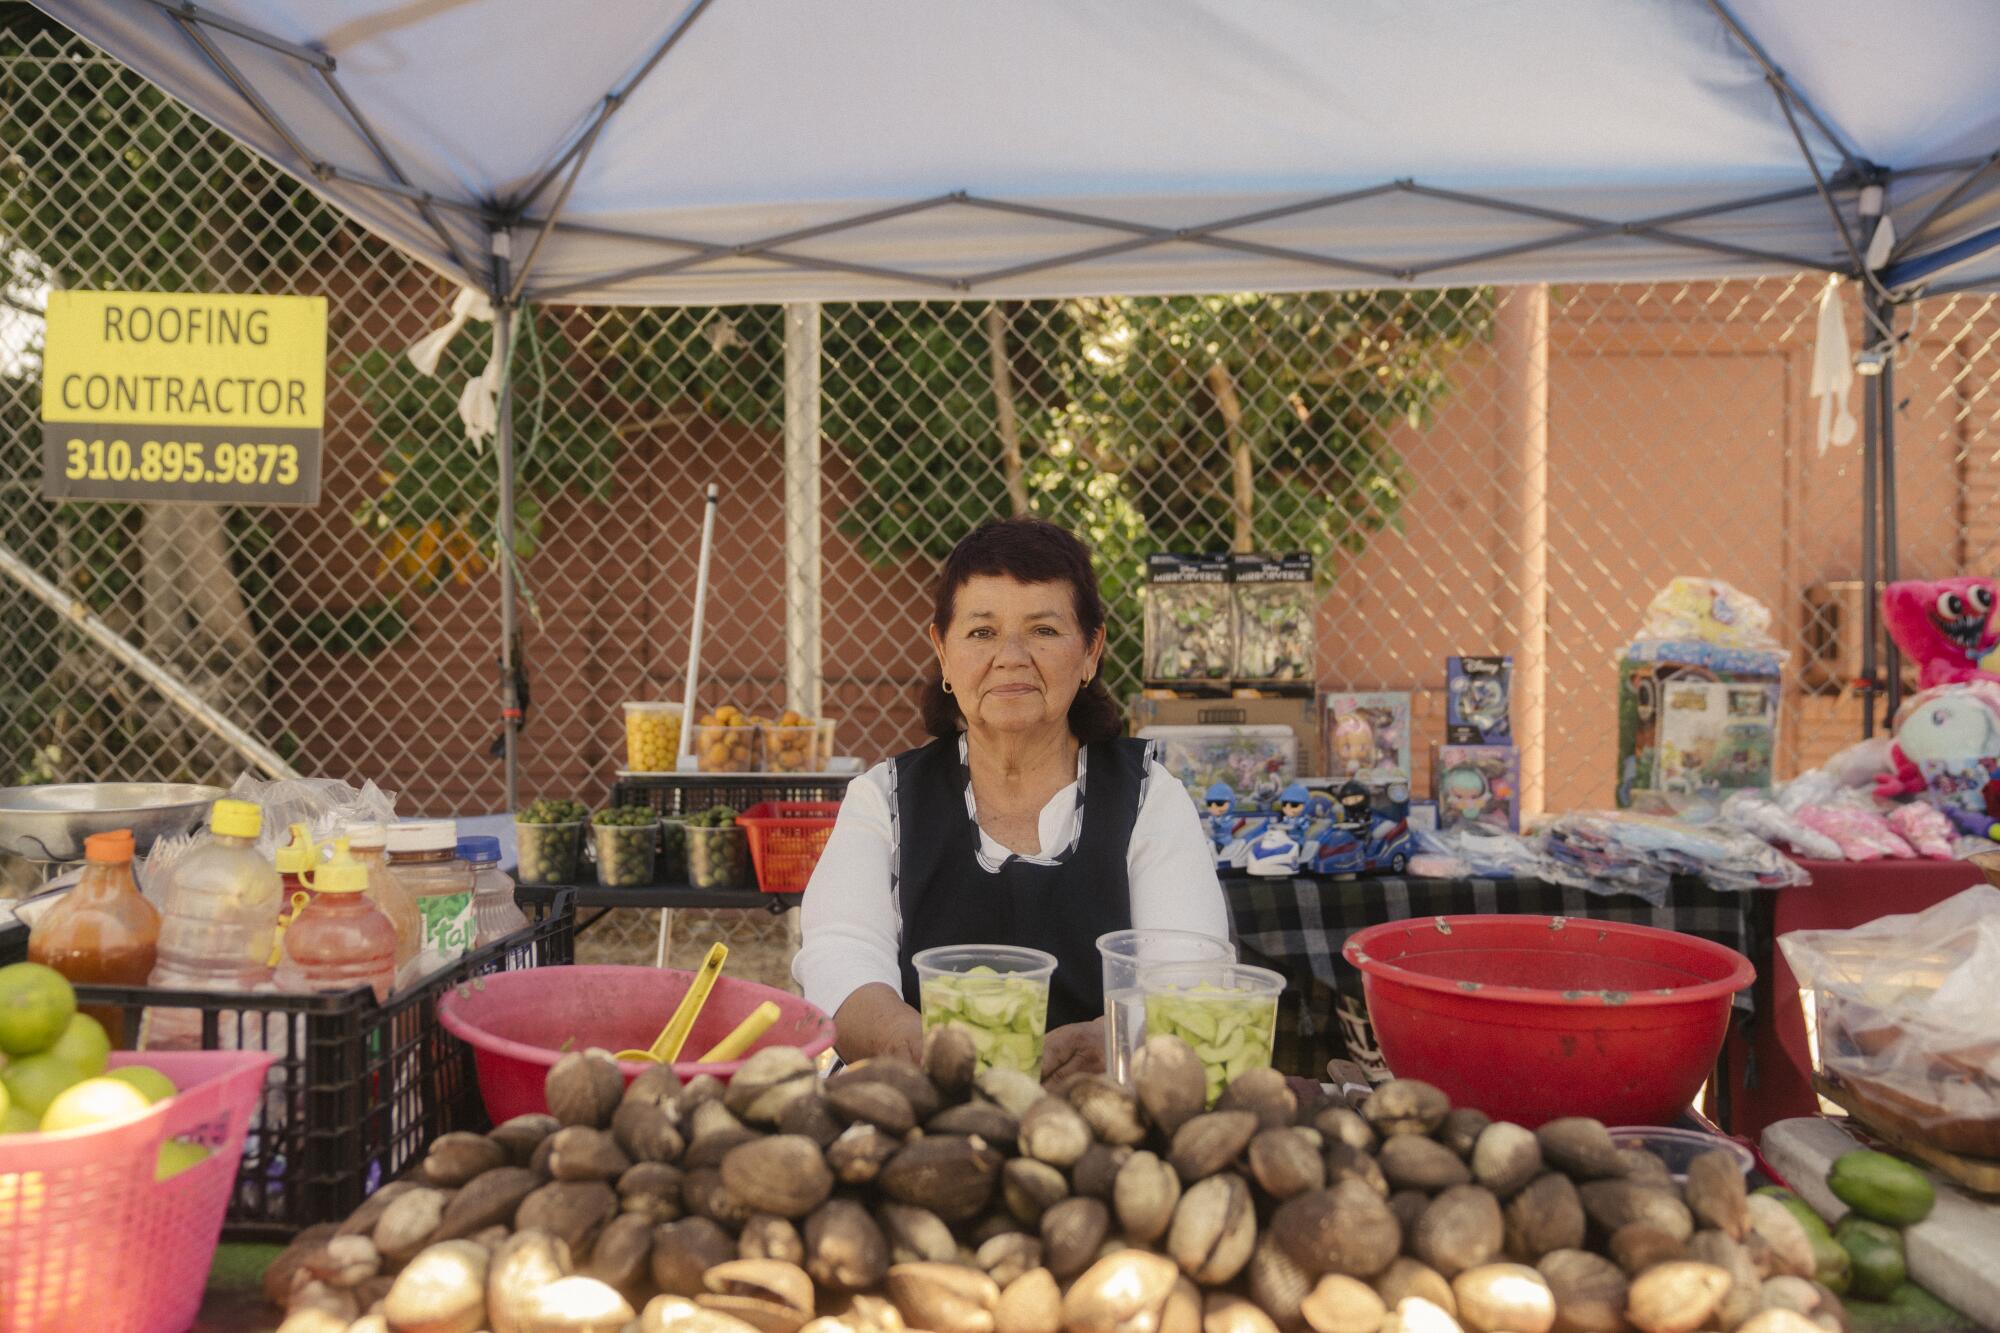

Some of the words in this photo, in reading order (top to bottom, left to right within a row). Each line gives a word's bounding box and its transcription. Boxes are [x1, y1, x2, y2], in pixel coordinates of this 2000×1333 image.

[104, 306, 270, 345] ROOFING
[61, 373, 307, 416] CONTRACTOR
[65, 438, 299, 485] 310.895.9873
[1463, 658, 1499, 674] Disney
